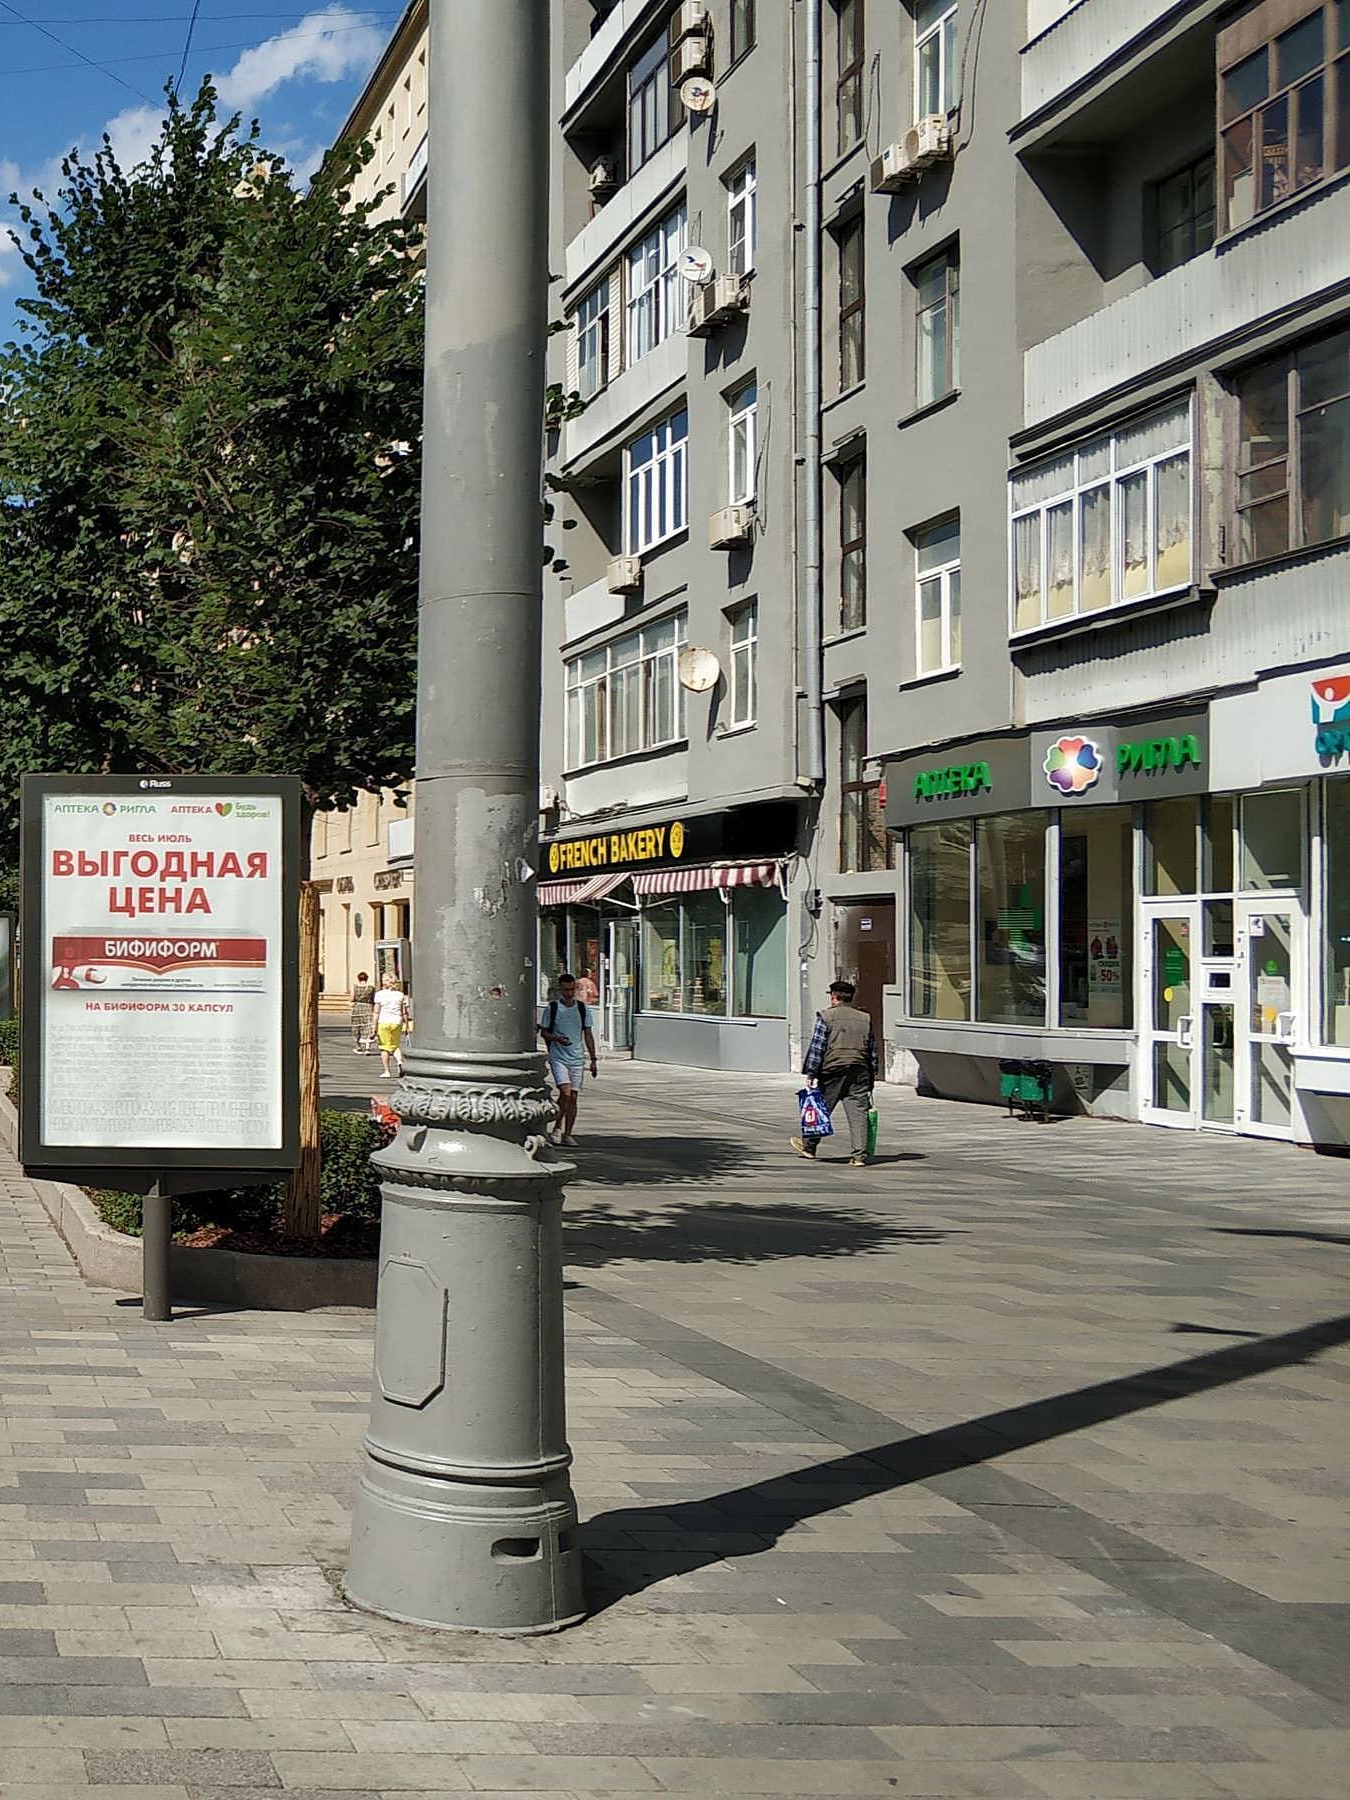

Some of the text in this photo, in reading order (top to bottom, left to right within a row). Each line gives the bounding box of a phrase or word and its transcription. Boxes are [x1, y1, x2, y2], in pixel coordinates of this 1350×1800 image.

[914, 761, 992, 798] АПТЕКА
[54, 804, 157, 814] АПТЕКА РИГЛА
[170, 805, 213, 815] АПТЕКА
[128, 834, 192, 843] ВЕСЬ ИЮЛЬ
[559, 827, 666, 870] FRENCH BAKERY
[52, 850, 268, 882] ВЫГОДНАЯ
[108, 887, 212, 918] ЦЕНА
[105, 940, 217, 958] БИФИФОРМ
[85, 1002, 234, 1013] НА БИФИФОРМ 30 КАПСУЛ
